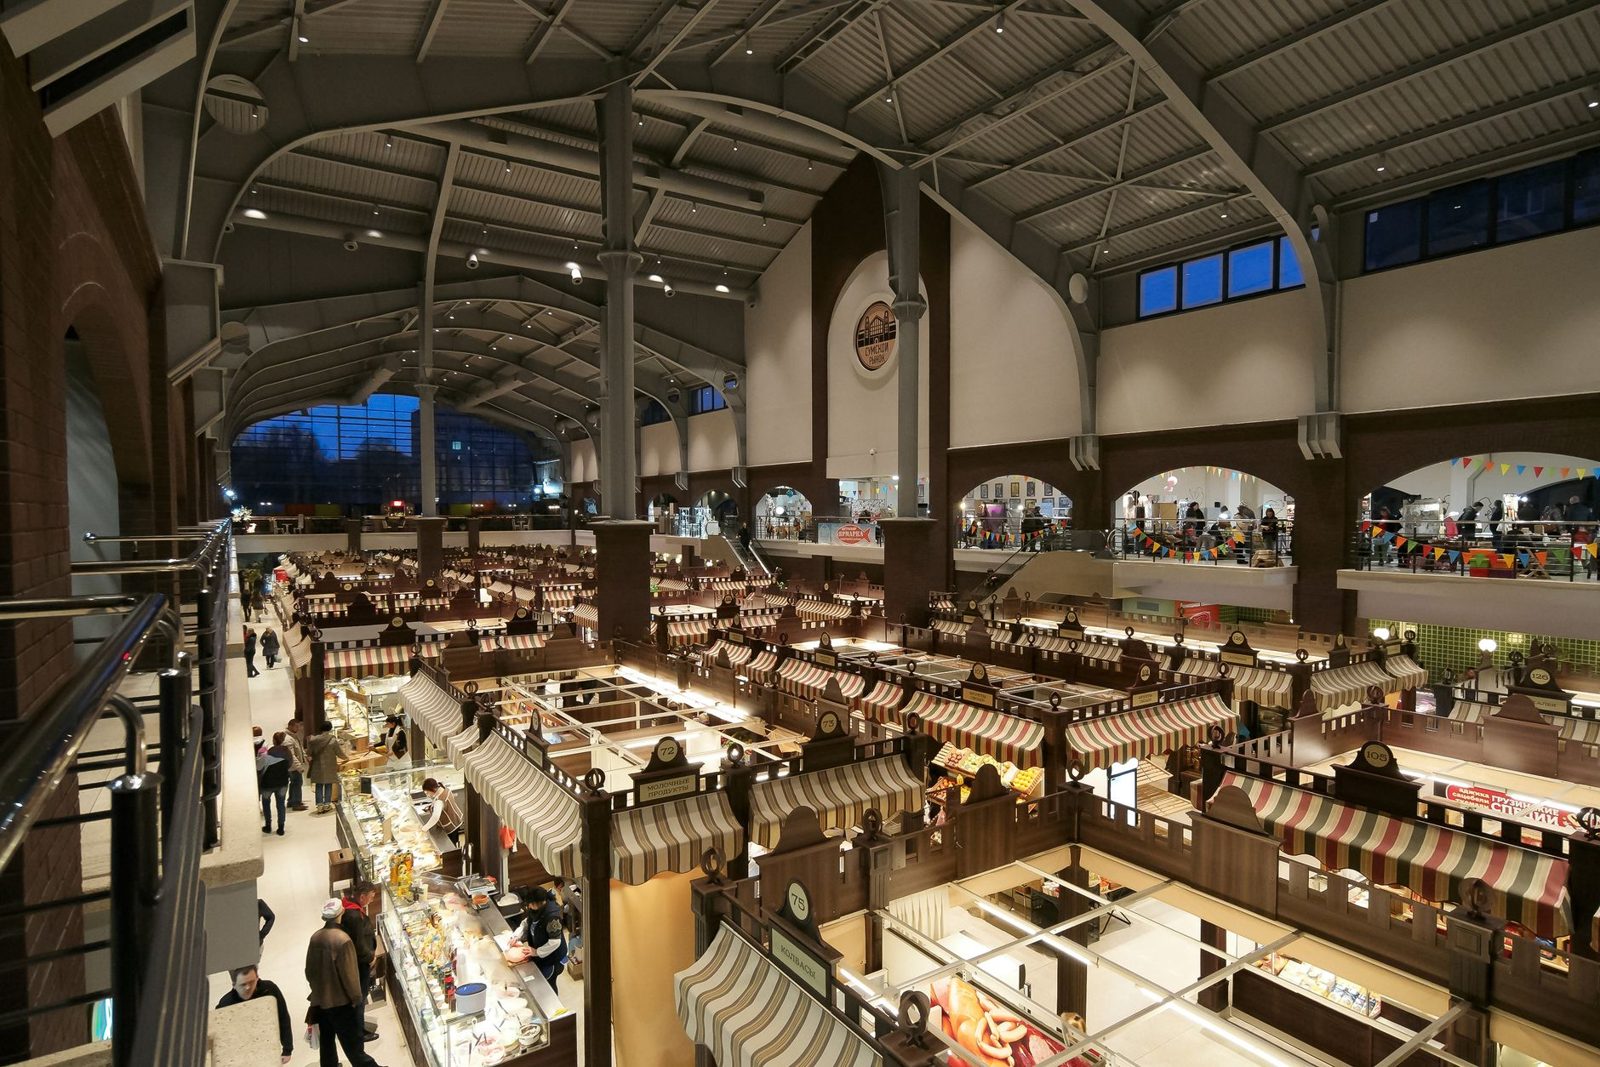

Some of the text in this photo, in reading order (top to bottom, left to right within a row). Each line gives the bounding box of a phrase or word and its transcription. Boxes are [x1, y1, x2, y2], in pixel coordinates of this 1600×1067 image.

[1532, 673, 1549, 681] 126
[660, 746, 675, 756] 72
[647, 778, 690, 792] МОЛОЧНЫЕ
[648, 785, 689, 798] ПРОДУКТЫ
[1491, 795, 1559, 815] ГРУЗИНКИЕ
[791, 893, 806, 912] 75
[780, 944, 816, 980] КОЛБАСЫ
